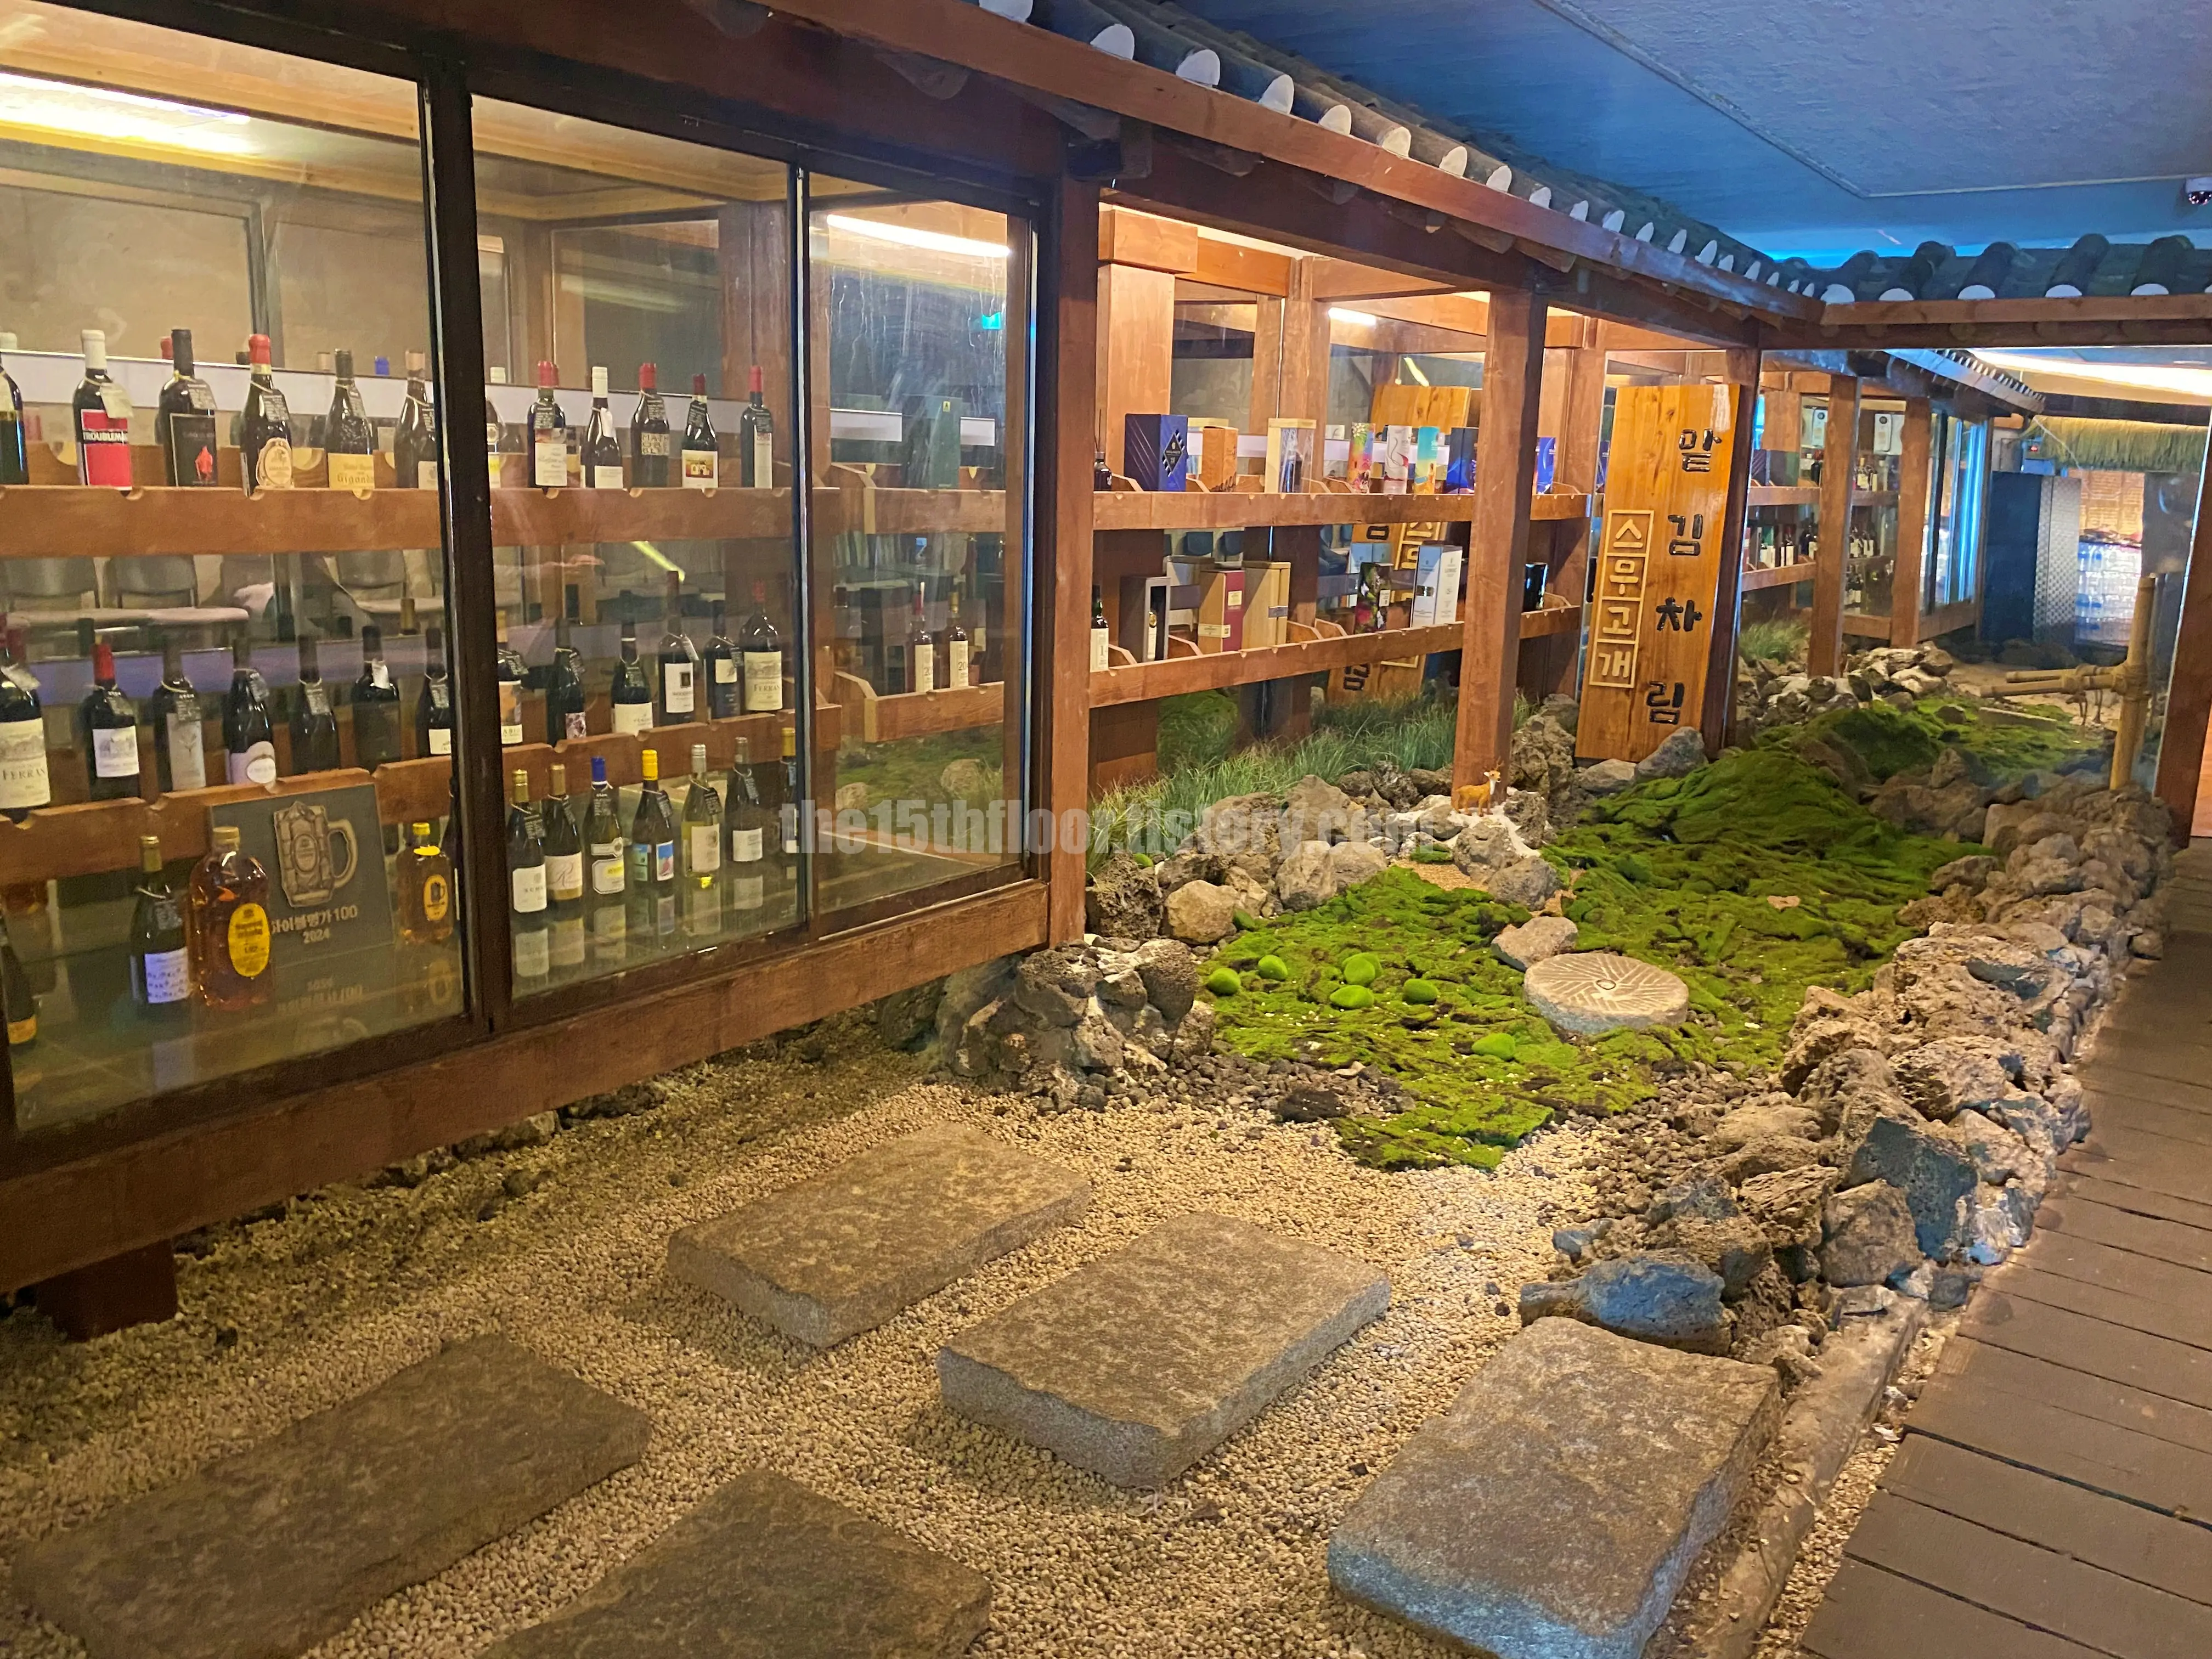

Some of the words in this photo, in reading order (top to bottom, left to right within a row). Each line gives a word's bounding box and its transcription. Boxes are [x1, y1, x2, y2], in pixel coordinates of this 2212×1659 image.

[1598, 518, 1644, 679] 스무고개
[1646, 428, 1722, 725] 맡김차림
[303, 928, 330, 944] 2024
